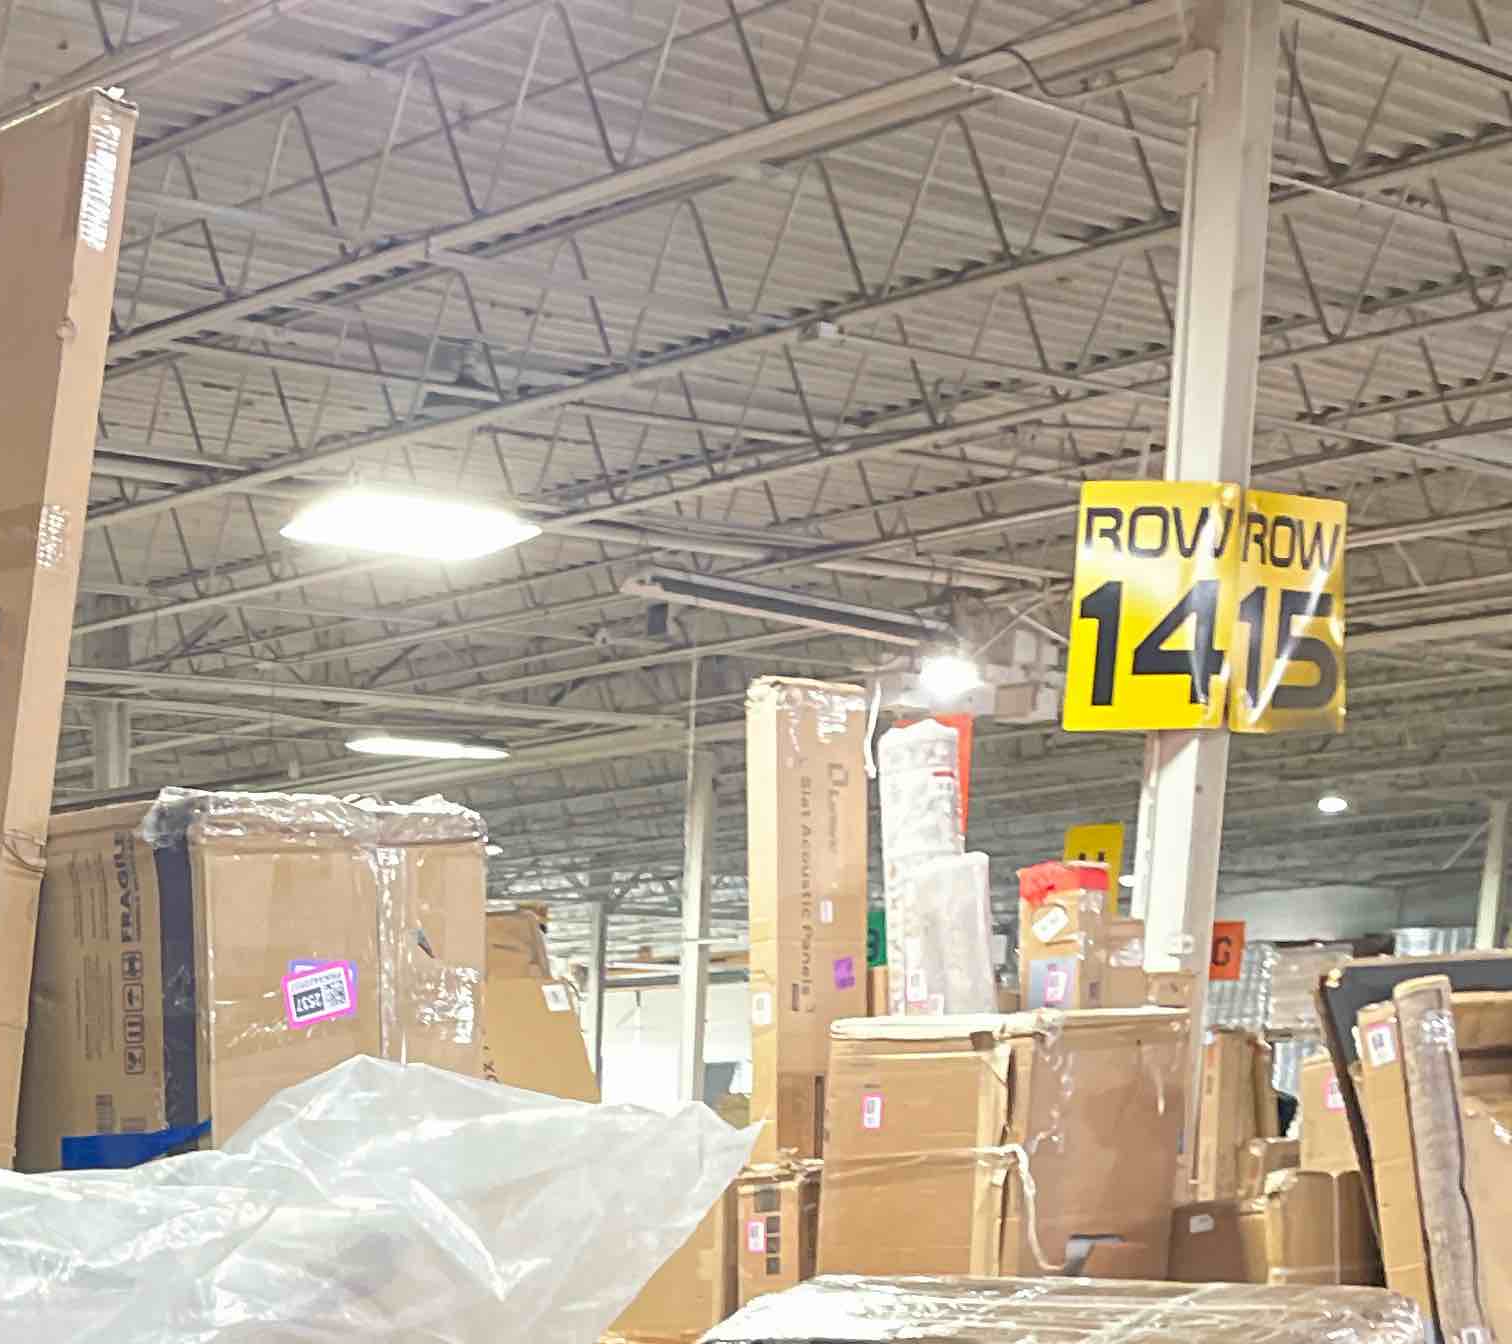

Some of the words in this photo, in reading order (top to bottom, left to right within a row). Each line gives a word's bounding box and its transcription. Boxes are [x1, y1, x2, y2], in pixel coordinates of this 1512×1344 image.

[1086, 506, 1233, 558] ROW
[1243, 511, 1340, 571] ROW
[1080, 580, 1225, 706] 14
[1240, 586, 1338, 711] 15
[1212, 936, 1232, 967] G
